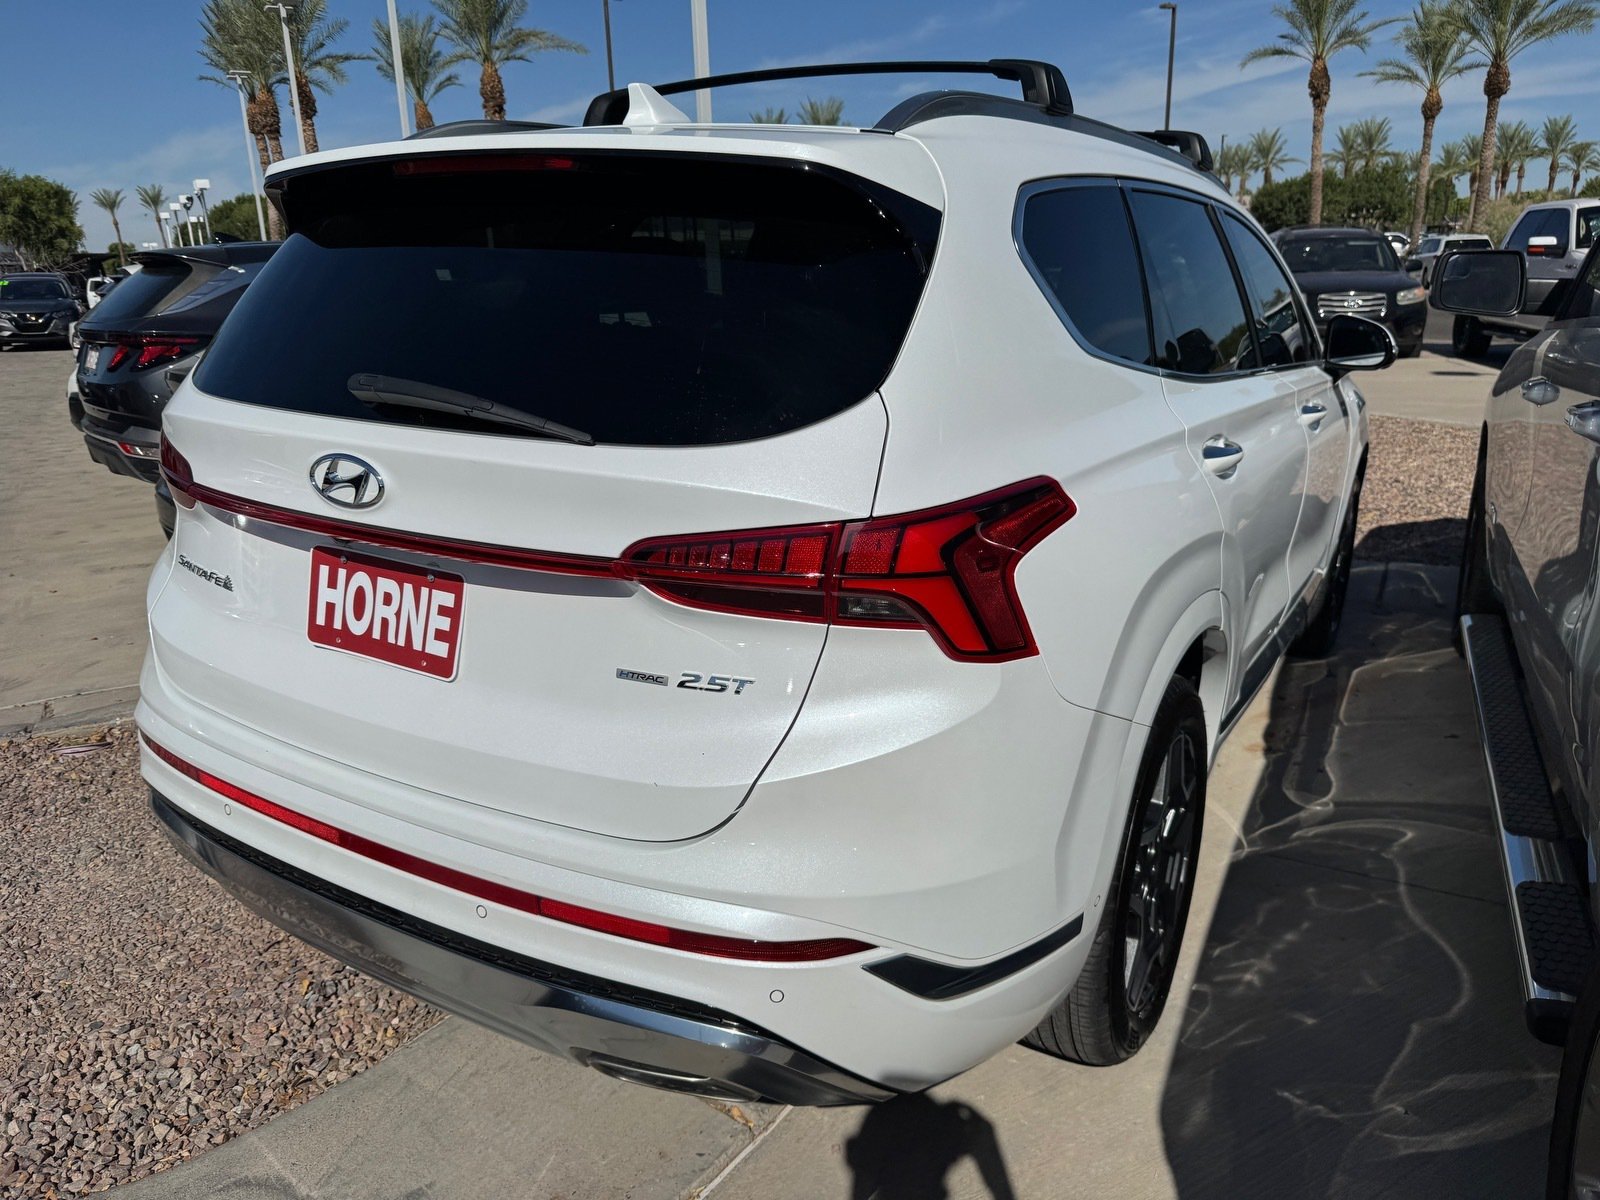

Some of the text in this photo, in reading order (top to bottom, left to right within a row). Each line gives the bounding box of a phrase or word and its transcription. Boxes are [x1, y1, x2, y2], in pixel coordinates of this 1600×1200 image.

[315, 564, 456, 659] HORNE
[618, 669, 757, 696] HTRAC 2.5T
